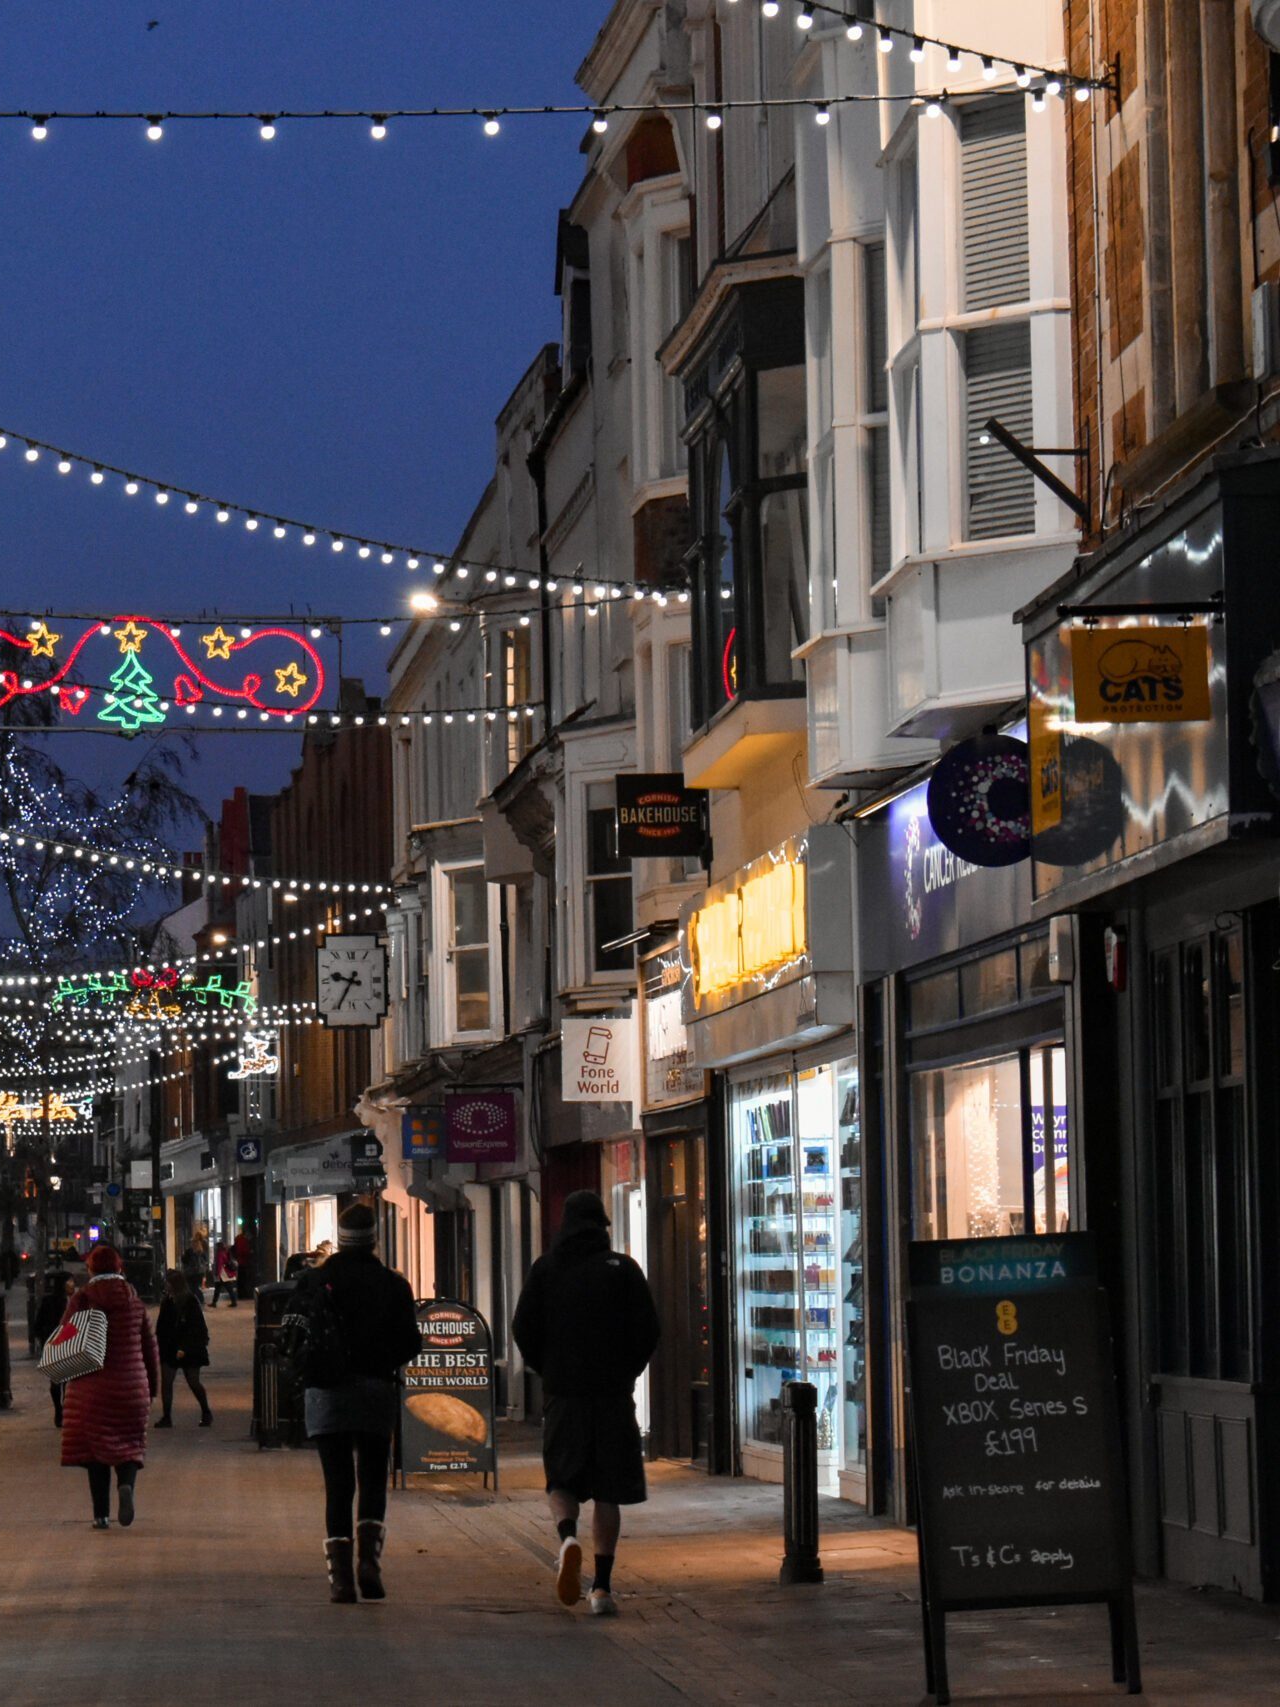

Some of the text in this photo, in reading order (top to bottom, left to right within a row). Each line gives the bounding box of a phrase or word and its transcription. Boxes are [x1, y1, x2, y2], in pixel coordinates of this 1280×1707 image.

[1099, 675, 1184, 703] CATS
[1103, 704, 1183, 713] PROTECTION
[621, 806, 697, 824] BAKEHOUSE
[577, 1065, 619, 1094] Fone World
[939, 1242, 1065, 1264] BLACK FRIDAY
[941, 1261, 1067, 1284] BONANZA
[429, 1312, 462, 1321] CORNISH
[445, 1353, 488, 1368] BEST
[937, 1342, 1066, 1376] Black Friday
[405, 1367, 488, 1377] CORNISH PASTY
[405, 1376, 489, 1386] IN THE WORLD
[975, 1372, 1019, 1392] Deal
[942, 1396, 1088, 1426] XBOX Series S
[984, 1427, 1038, 1456] £199
[942, 1484, 965, 1499] Ask
[1035, 1480, 1056, 1490] for
[1059, 1476, 1101, 1490] details
[950, 1546, 981, 1567] T's
[999, 1544, 1021, 1564] C's
[1031, 1548, 1075, 1569] apply
